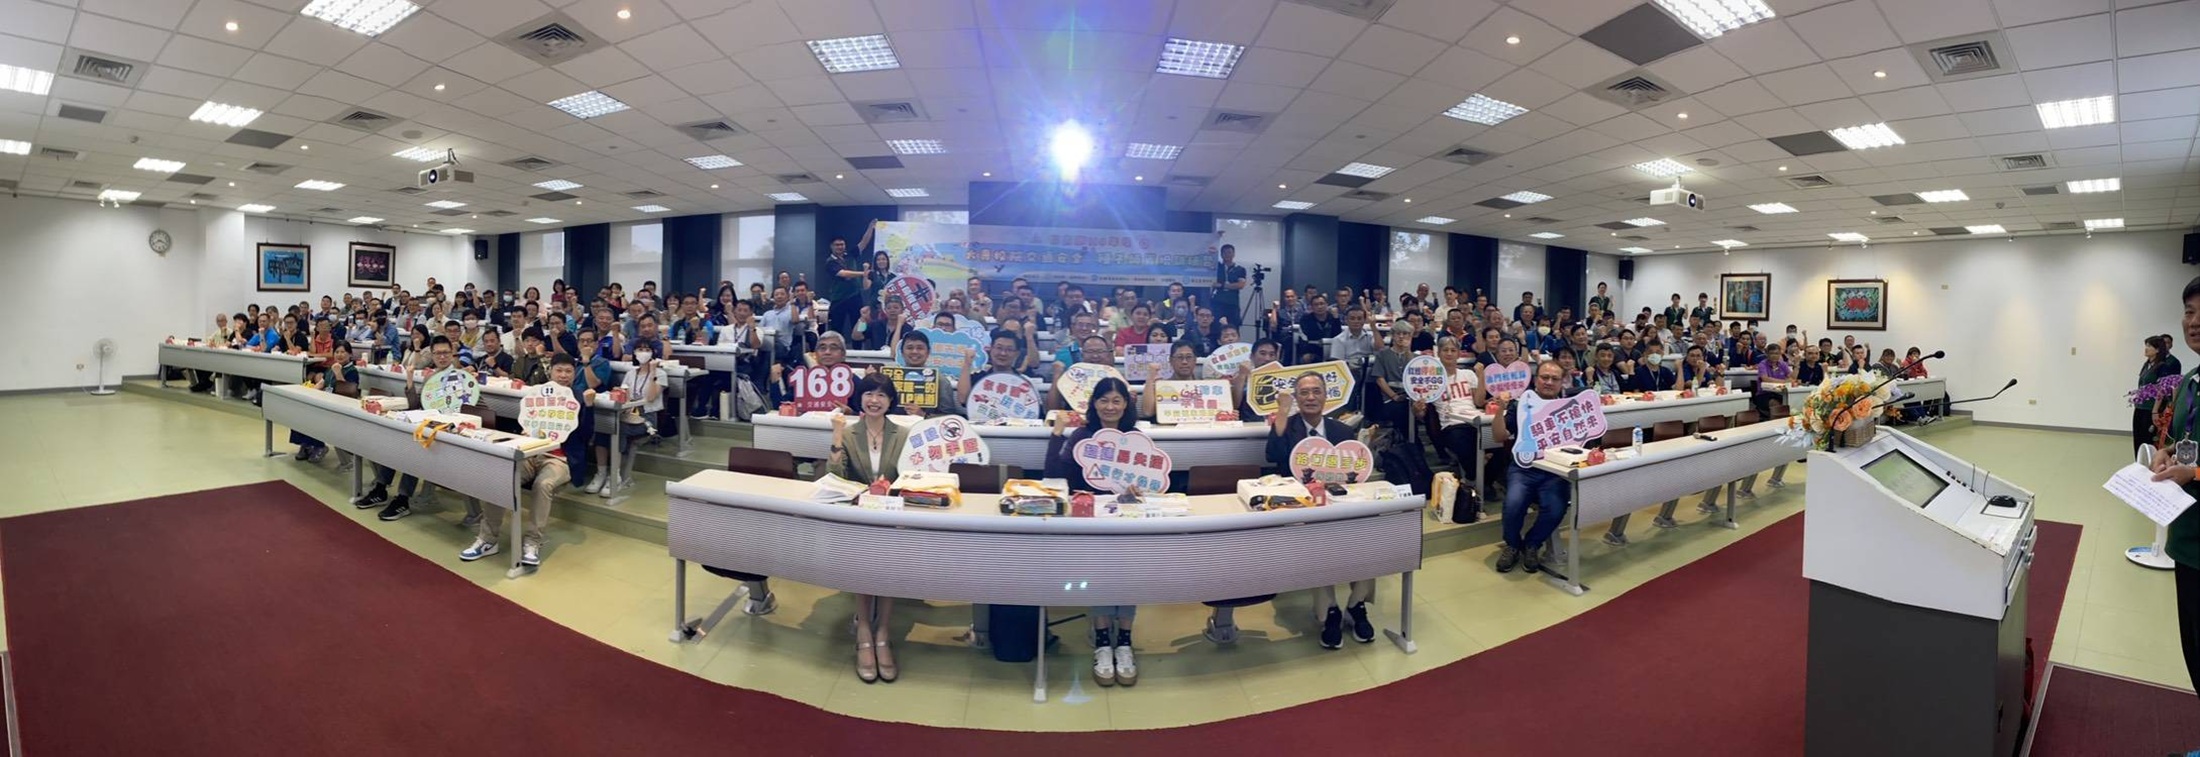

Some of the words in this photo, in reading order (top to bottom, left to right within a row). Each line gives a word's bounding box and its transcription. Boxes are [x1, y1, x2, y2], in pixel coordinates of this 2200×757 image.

[790, 366, 851, 398] 168
[1530, 400, 1594, 437] 騎車不搶快
[1537, 415, 1598, 450] 平安自然來
